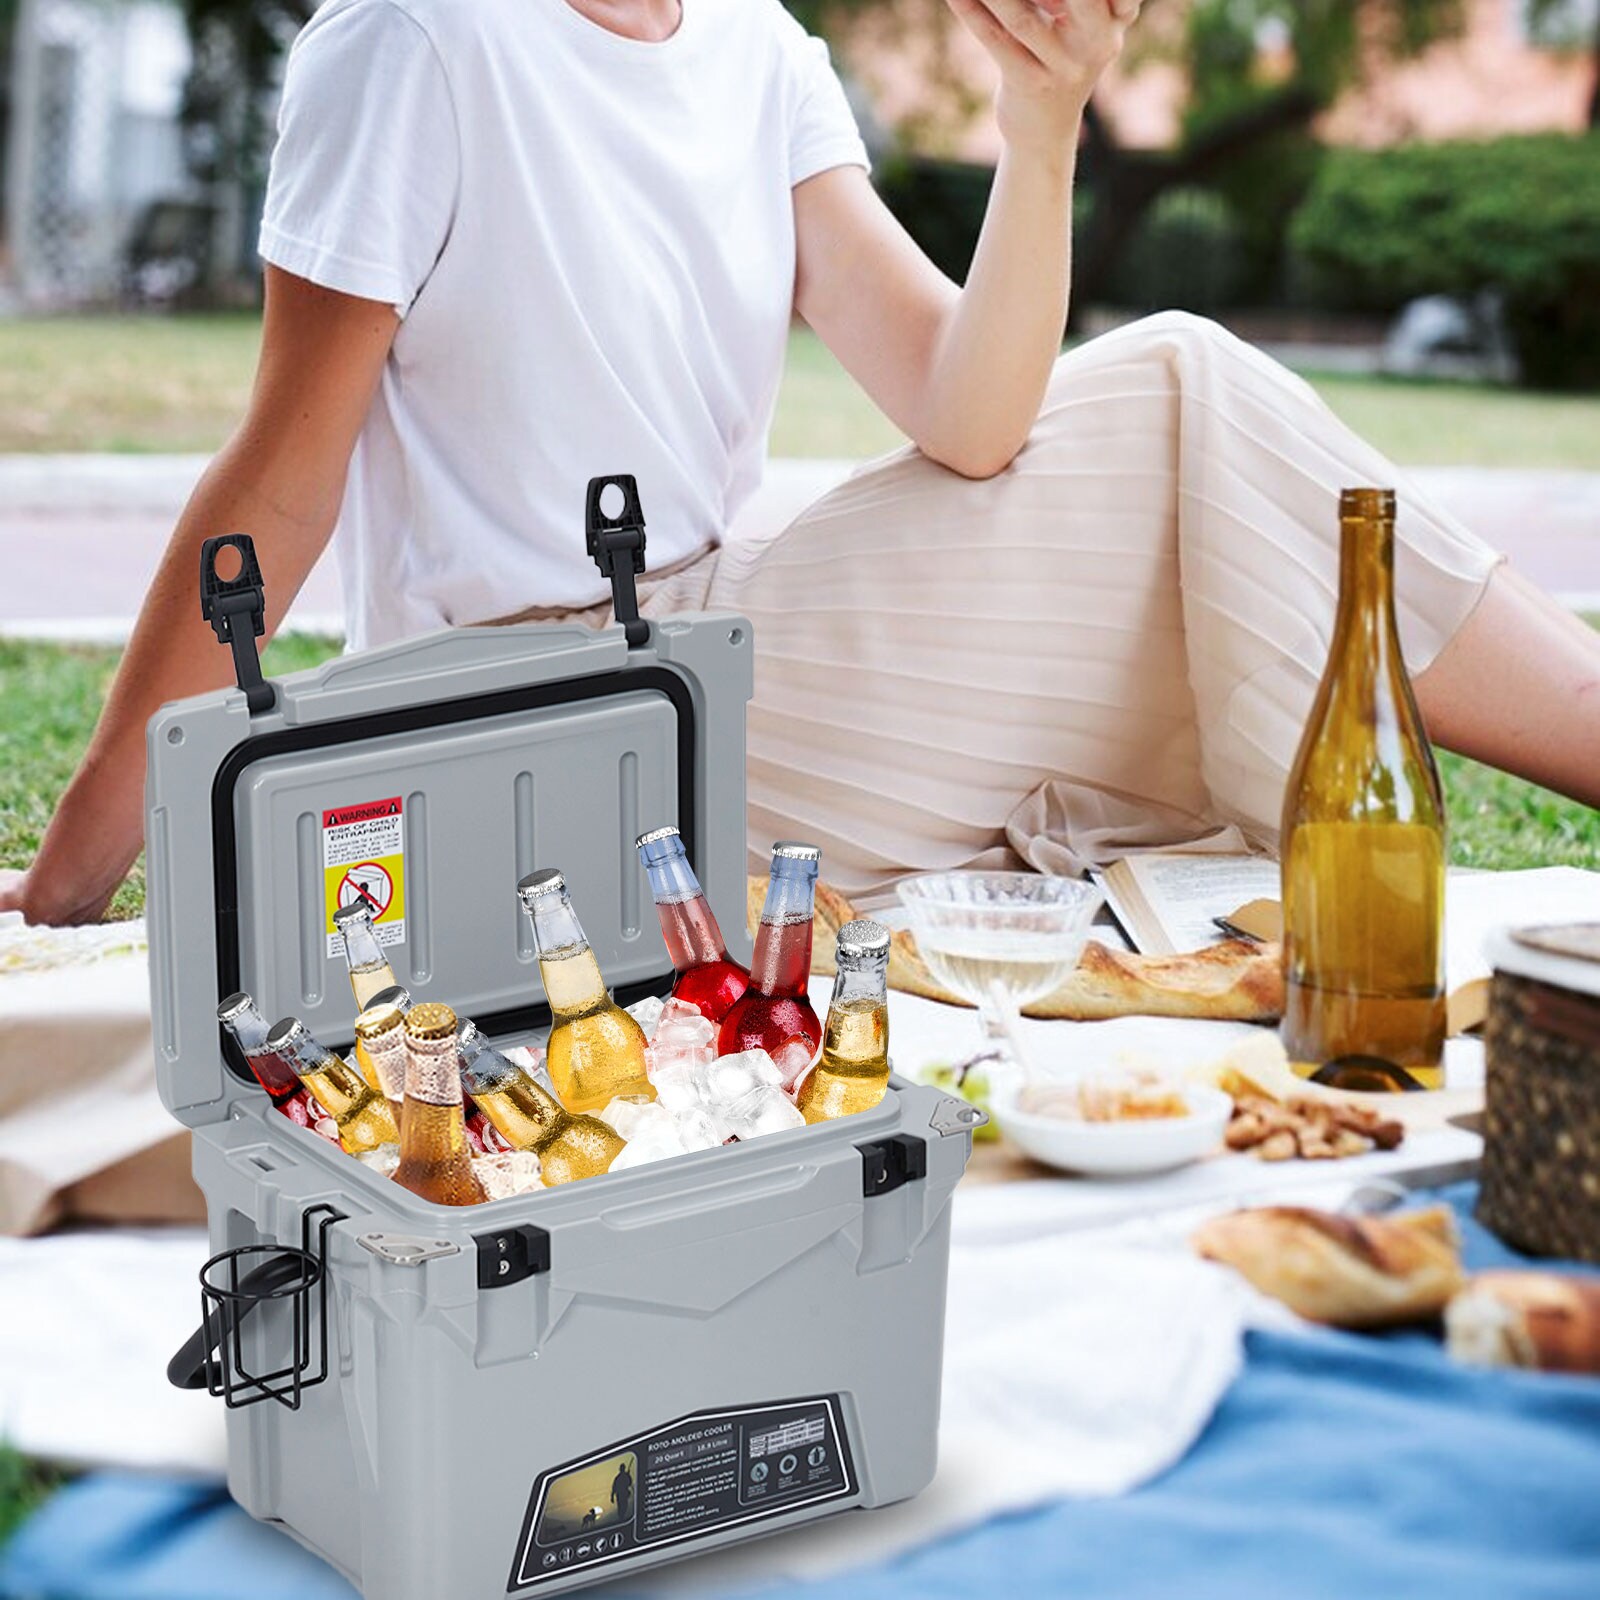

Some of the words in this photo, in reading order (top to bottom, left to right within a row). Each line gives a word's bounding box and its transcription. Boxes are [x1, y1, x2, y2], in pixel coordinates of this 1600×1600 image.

[340, 805, 386, 822] WARNING
[328, 826, 351, 836] RISK
[369, 816, 399, 827] CHILD
[330, 824, 396, 841] ENTRAPMENT
[703, 1422, 733, 1437] COOLER
[664, 1450, 684, 1463] Quart
